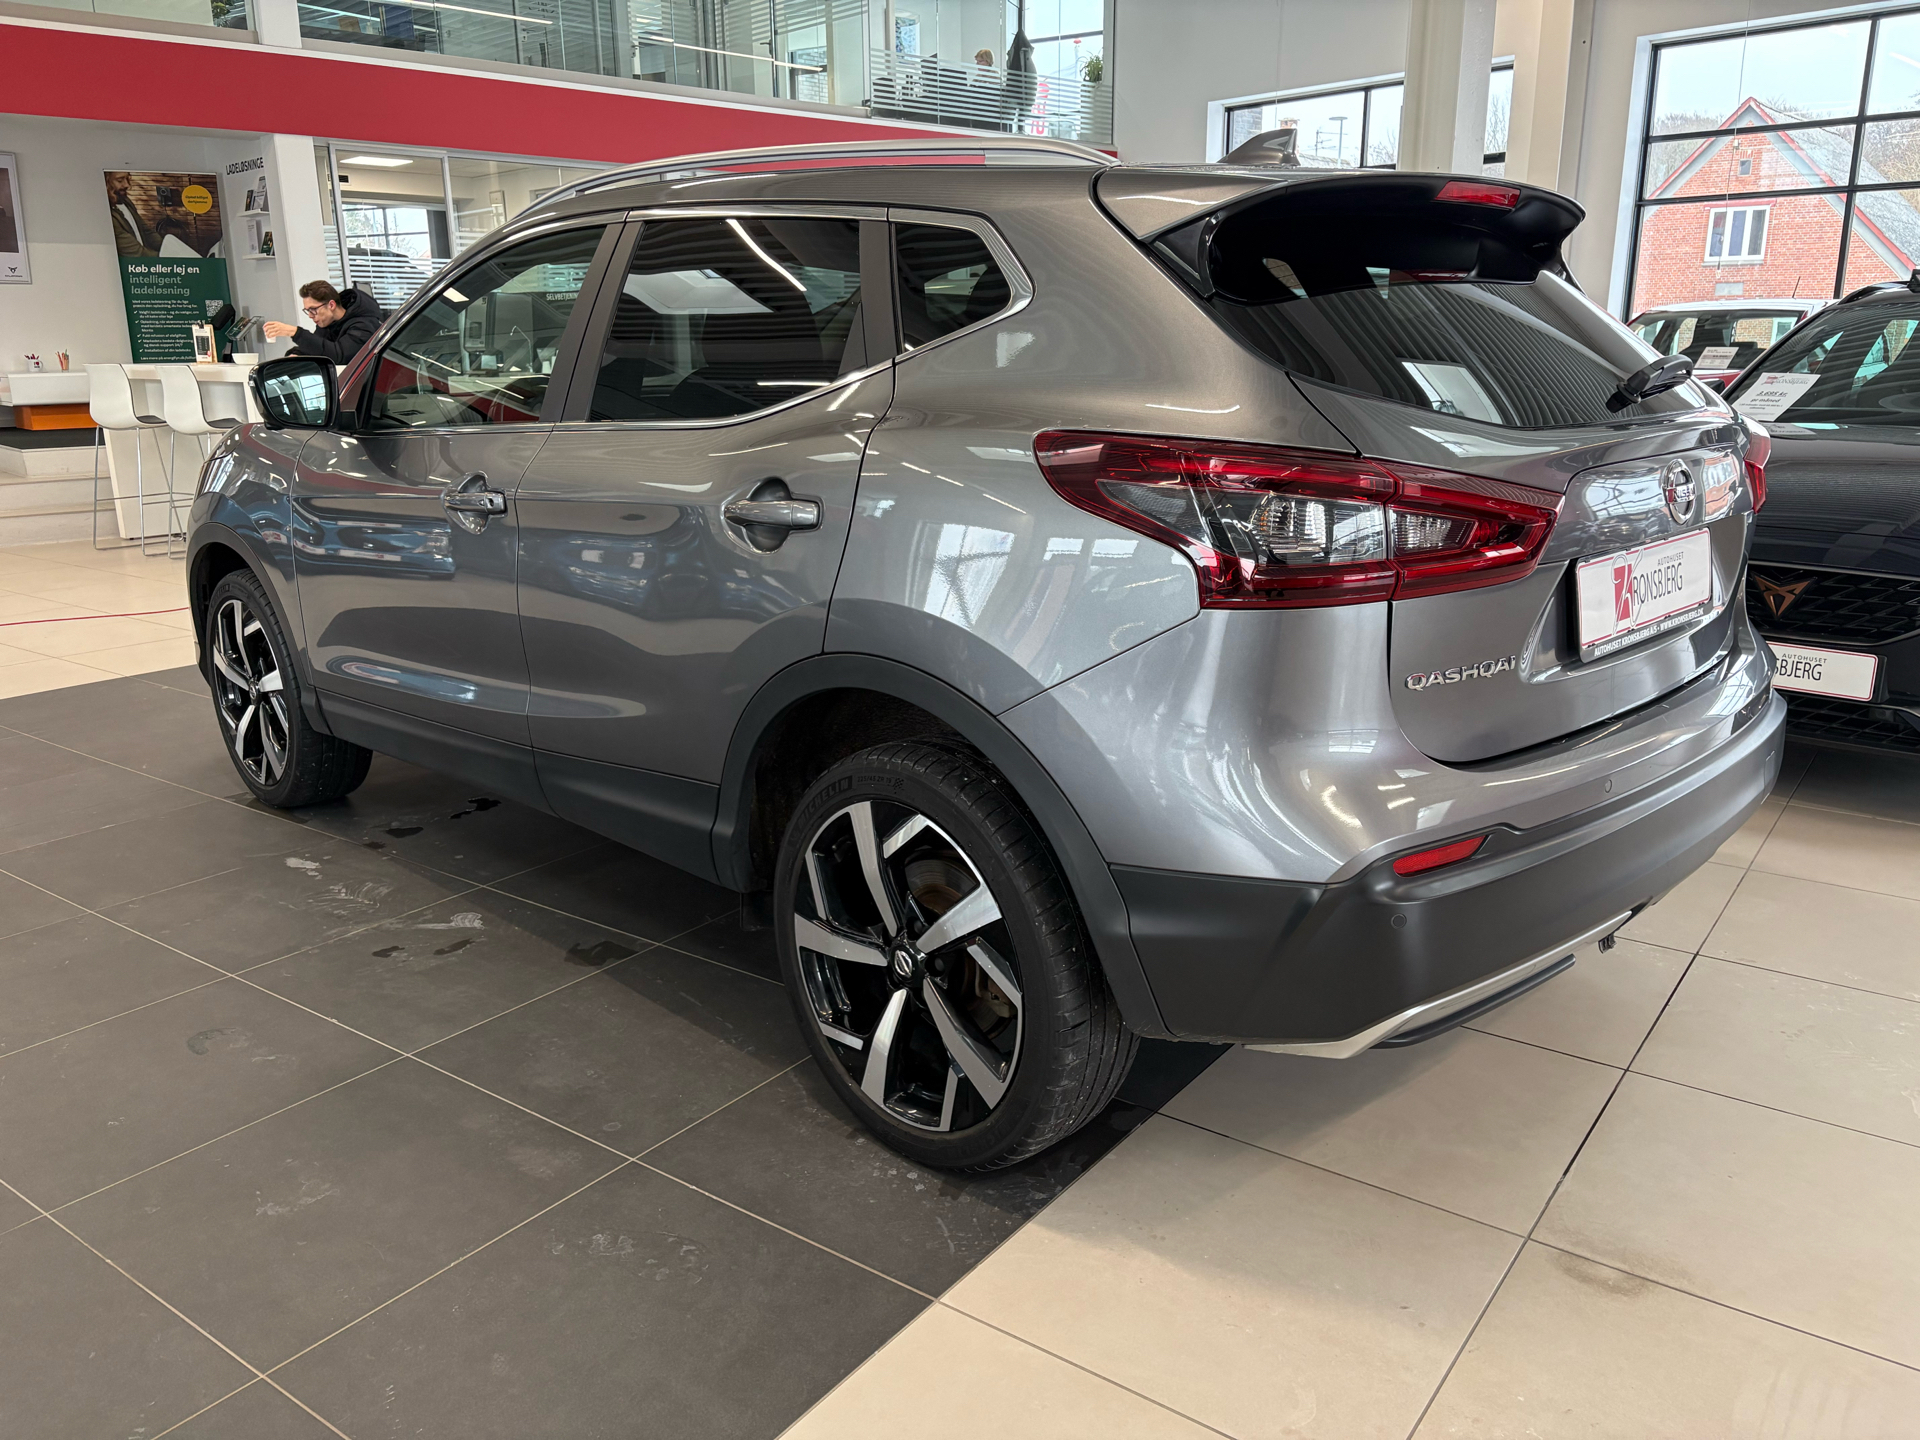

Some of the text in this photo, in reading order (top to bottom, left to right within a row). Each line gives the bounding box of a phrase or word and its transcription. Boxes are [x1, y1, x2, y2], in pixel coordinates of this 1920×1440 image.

[128, 264, 200, 276] Køb eller lej en
[129, 275, 182, 286] intelligent
[131, 285, 190, 297] ladeløsning
[1657, 552, 1684, 566] AUTOHUSET
[1781, 653, 1828, 664] AUTOHUSET
[1405, 655, 1516, 691] QASHQAI
